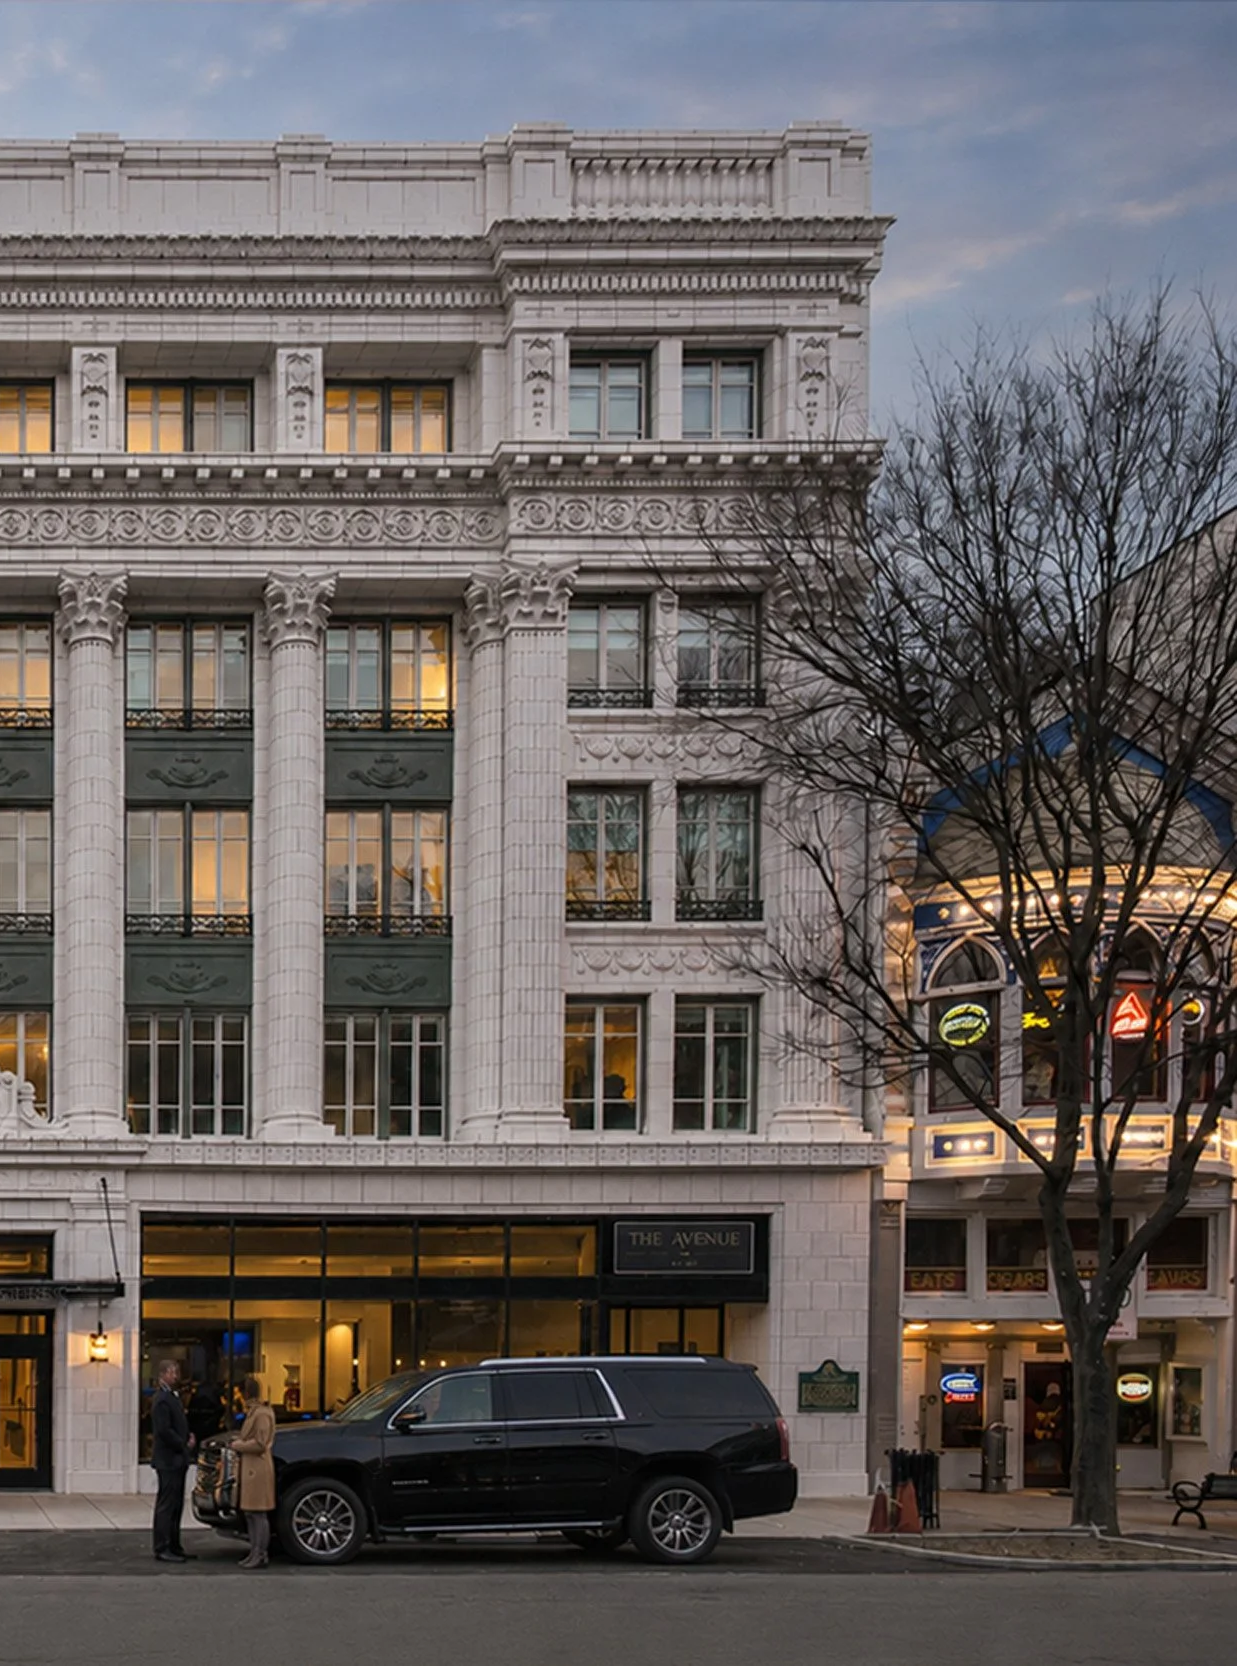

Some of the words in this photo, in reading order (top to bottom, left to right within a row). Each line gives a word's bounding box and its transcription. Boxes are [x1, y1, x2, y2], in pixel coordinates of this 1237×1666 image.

[628, 1231, 663, 1246] THE
[671, 1231, 741, 1249] AVENUE
[910, 1271, 956, 1288] EATS
[988, 1271, 1046, 1288] CIGARS
